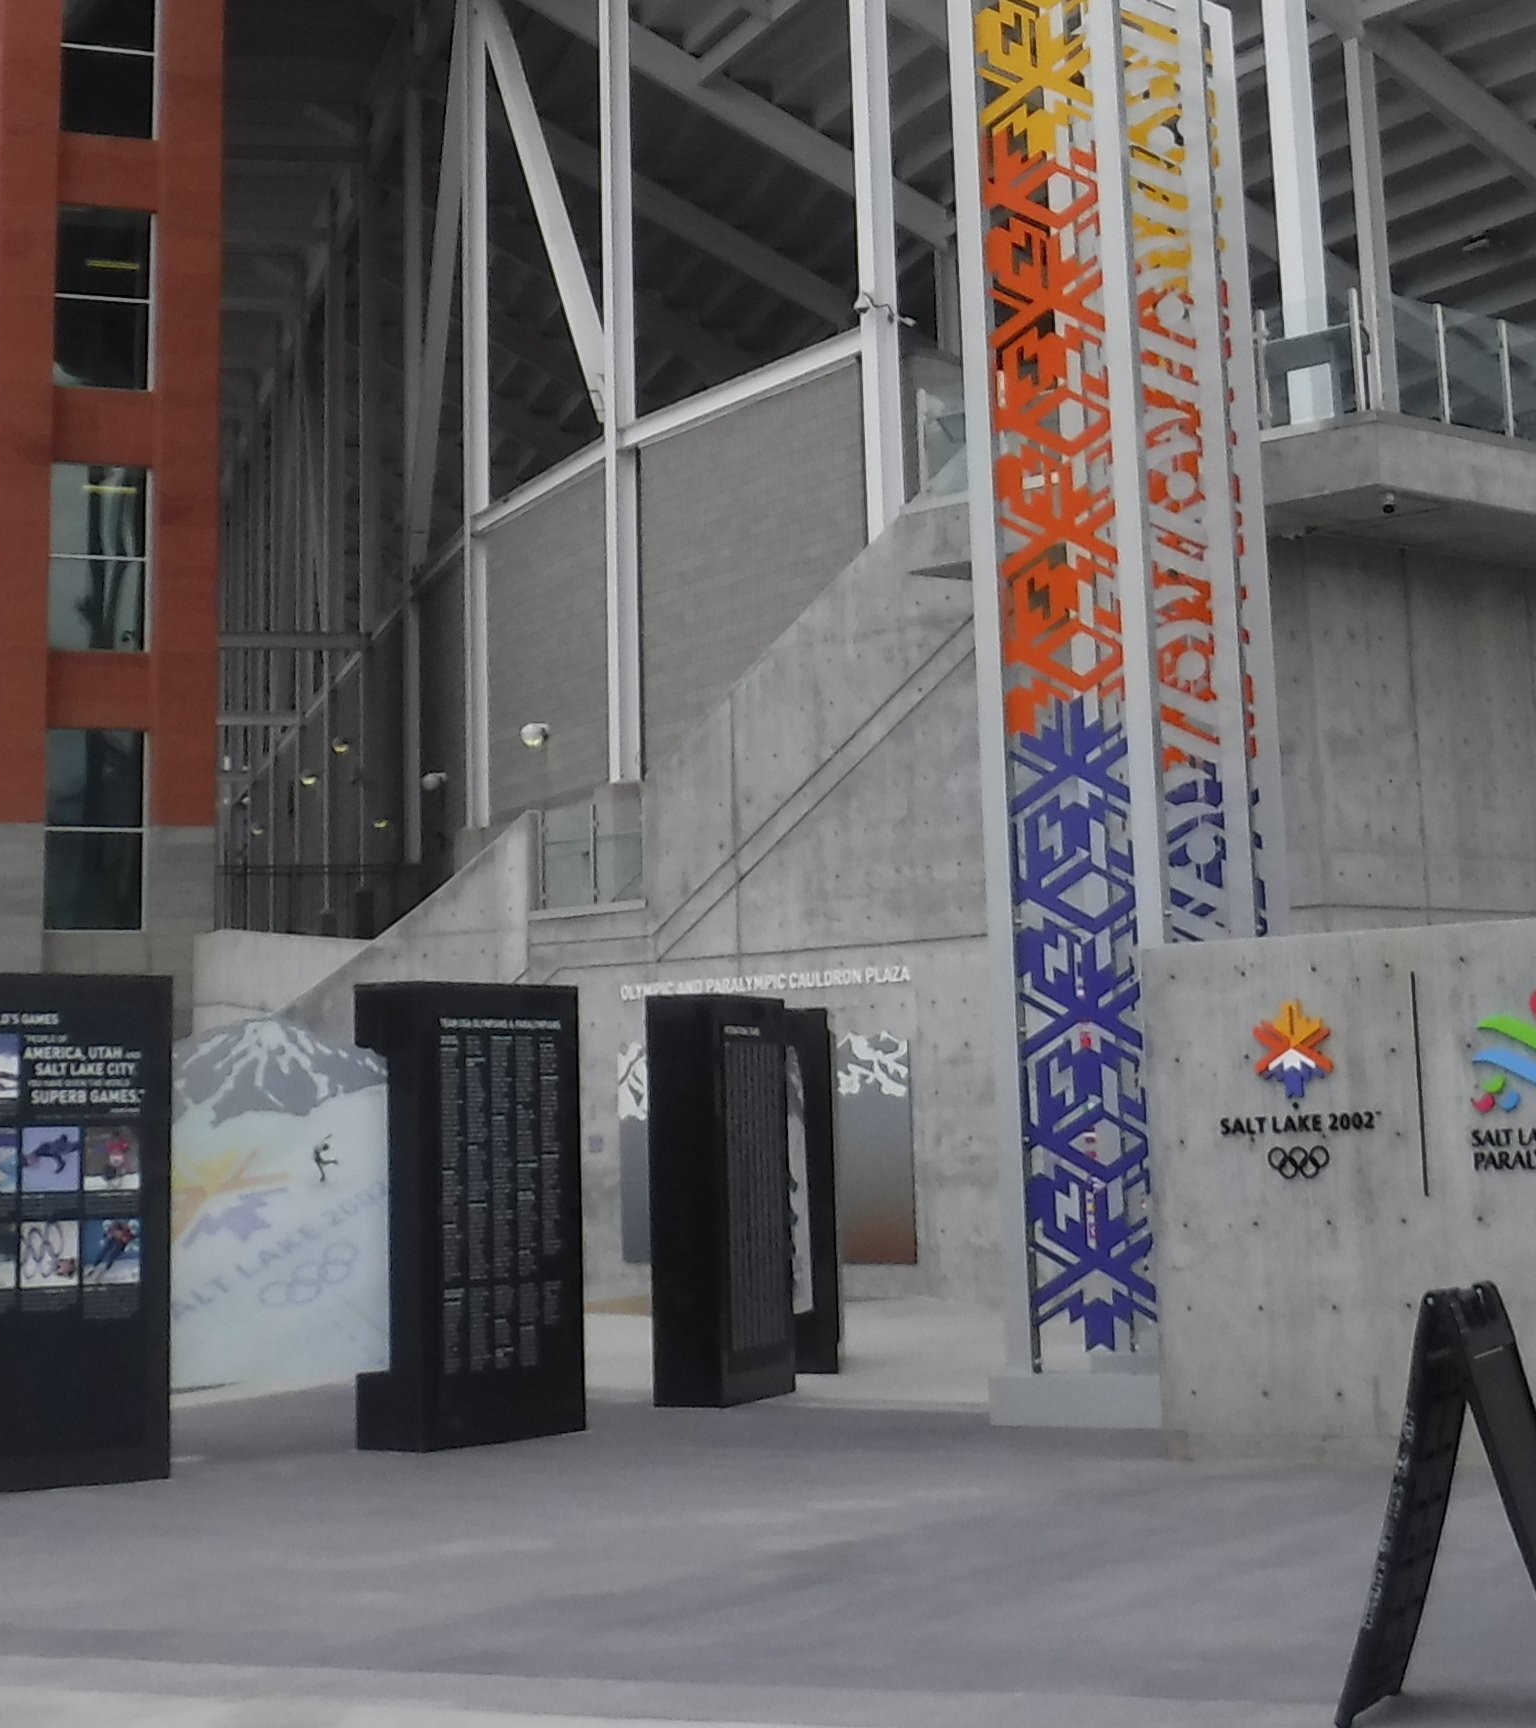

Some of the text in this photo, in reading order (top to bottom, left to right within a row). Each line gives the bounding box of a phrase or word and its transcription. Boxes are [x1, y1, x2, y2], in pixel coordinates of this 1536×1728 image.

[706, 972, 787, 993] PARALYMPIC
[789, 968, 862, 989] CAULDRON
[864, 965, 911, 984] PLAZA
[21, 1012, 59, 1025] GAMES
[23, 1046, 87, 1061] AMERICA,
[88, 1046, 122, 1060] UTAH
[35, 1063, 68, 1076] SALT
[70, 1063, 105, 1076] LAKE
[31, 1089, 88, 1104] SUPERB
[1220, 1111, 1378, 1136] SALT LAKE 2002
[1471, 1127, 1514, 1148] SALT
[171, 1276, 230, 1320] ALT
